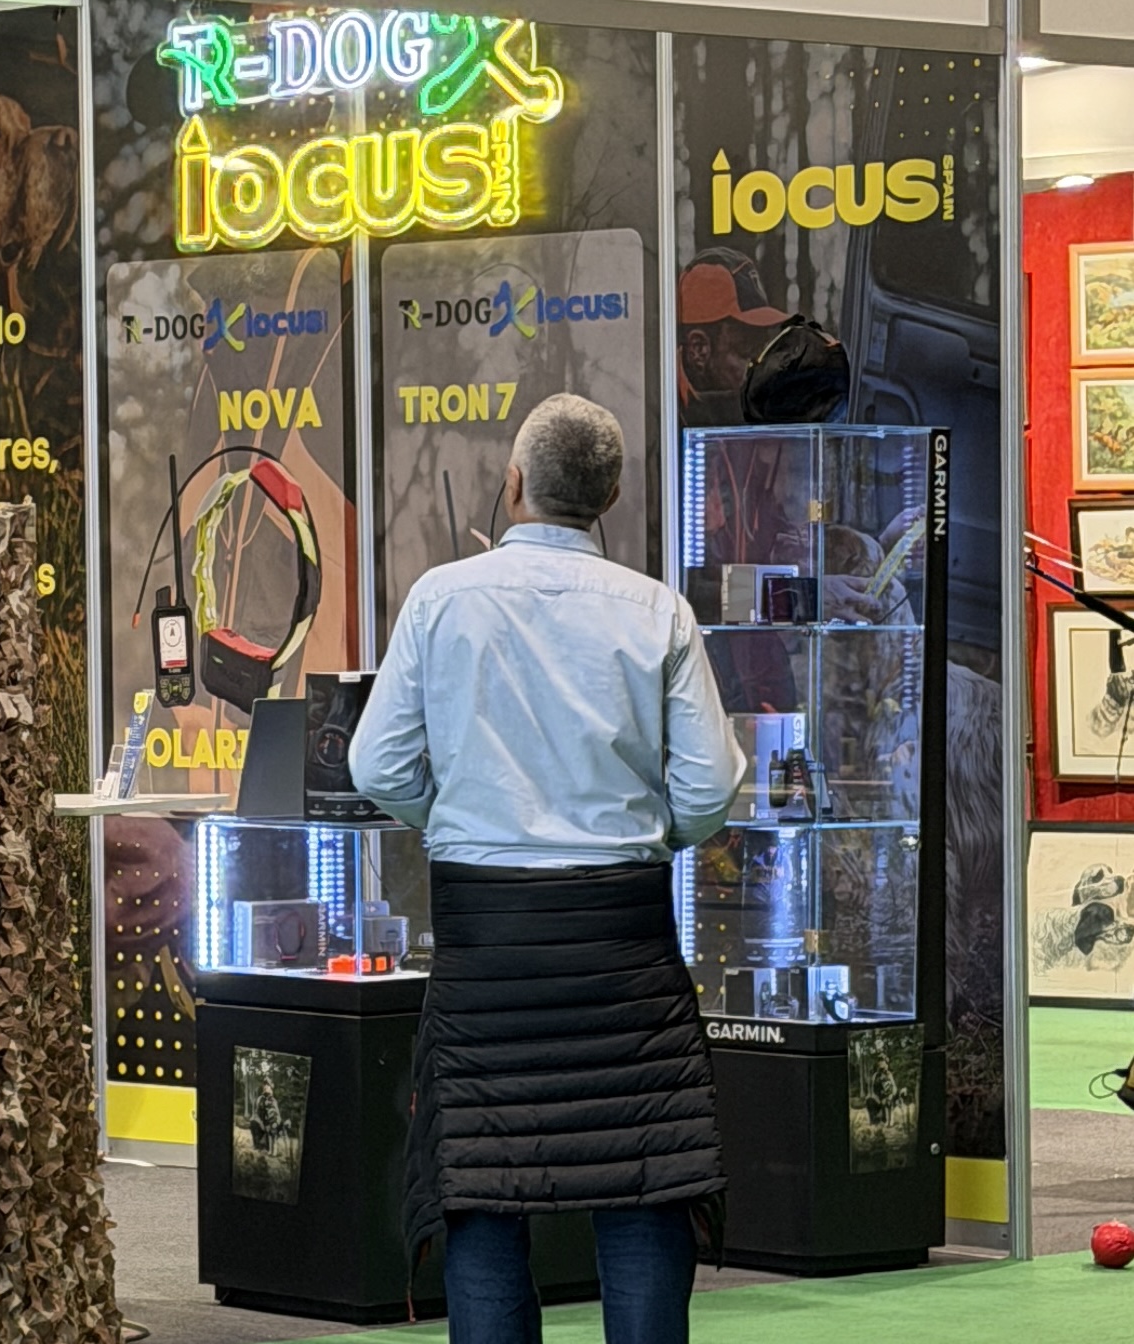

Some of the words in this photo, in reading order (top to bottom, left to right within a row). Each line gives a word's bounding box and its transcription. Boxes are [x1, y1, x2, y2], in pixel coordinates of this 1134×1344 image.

[943, 154, 954, 220] SPAIN
[219, 386, 322, 432] NOVA
[399, 384, 489, 424] TRON
[495, 382, 518, 421] 7
[934, 434, 947, 536] GARMIN
[706, 1022, 783, 1044] GARMIN
